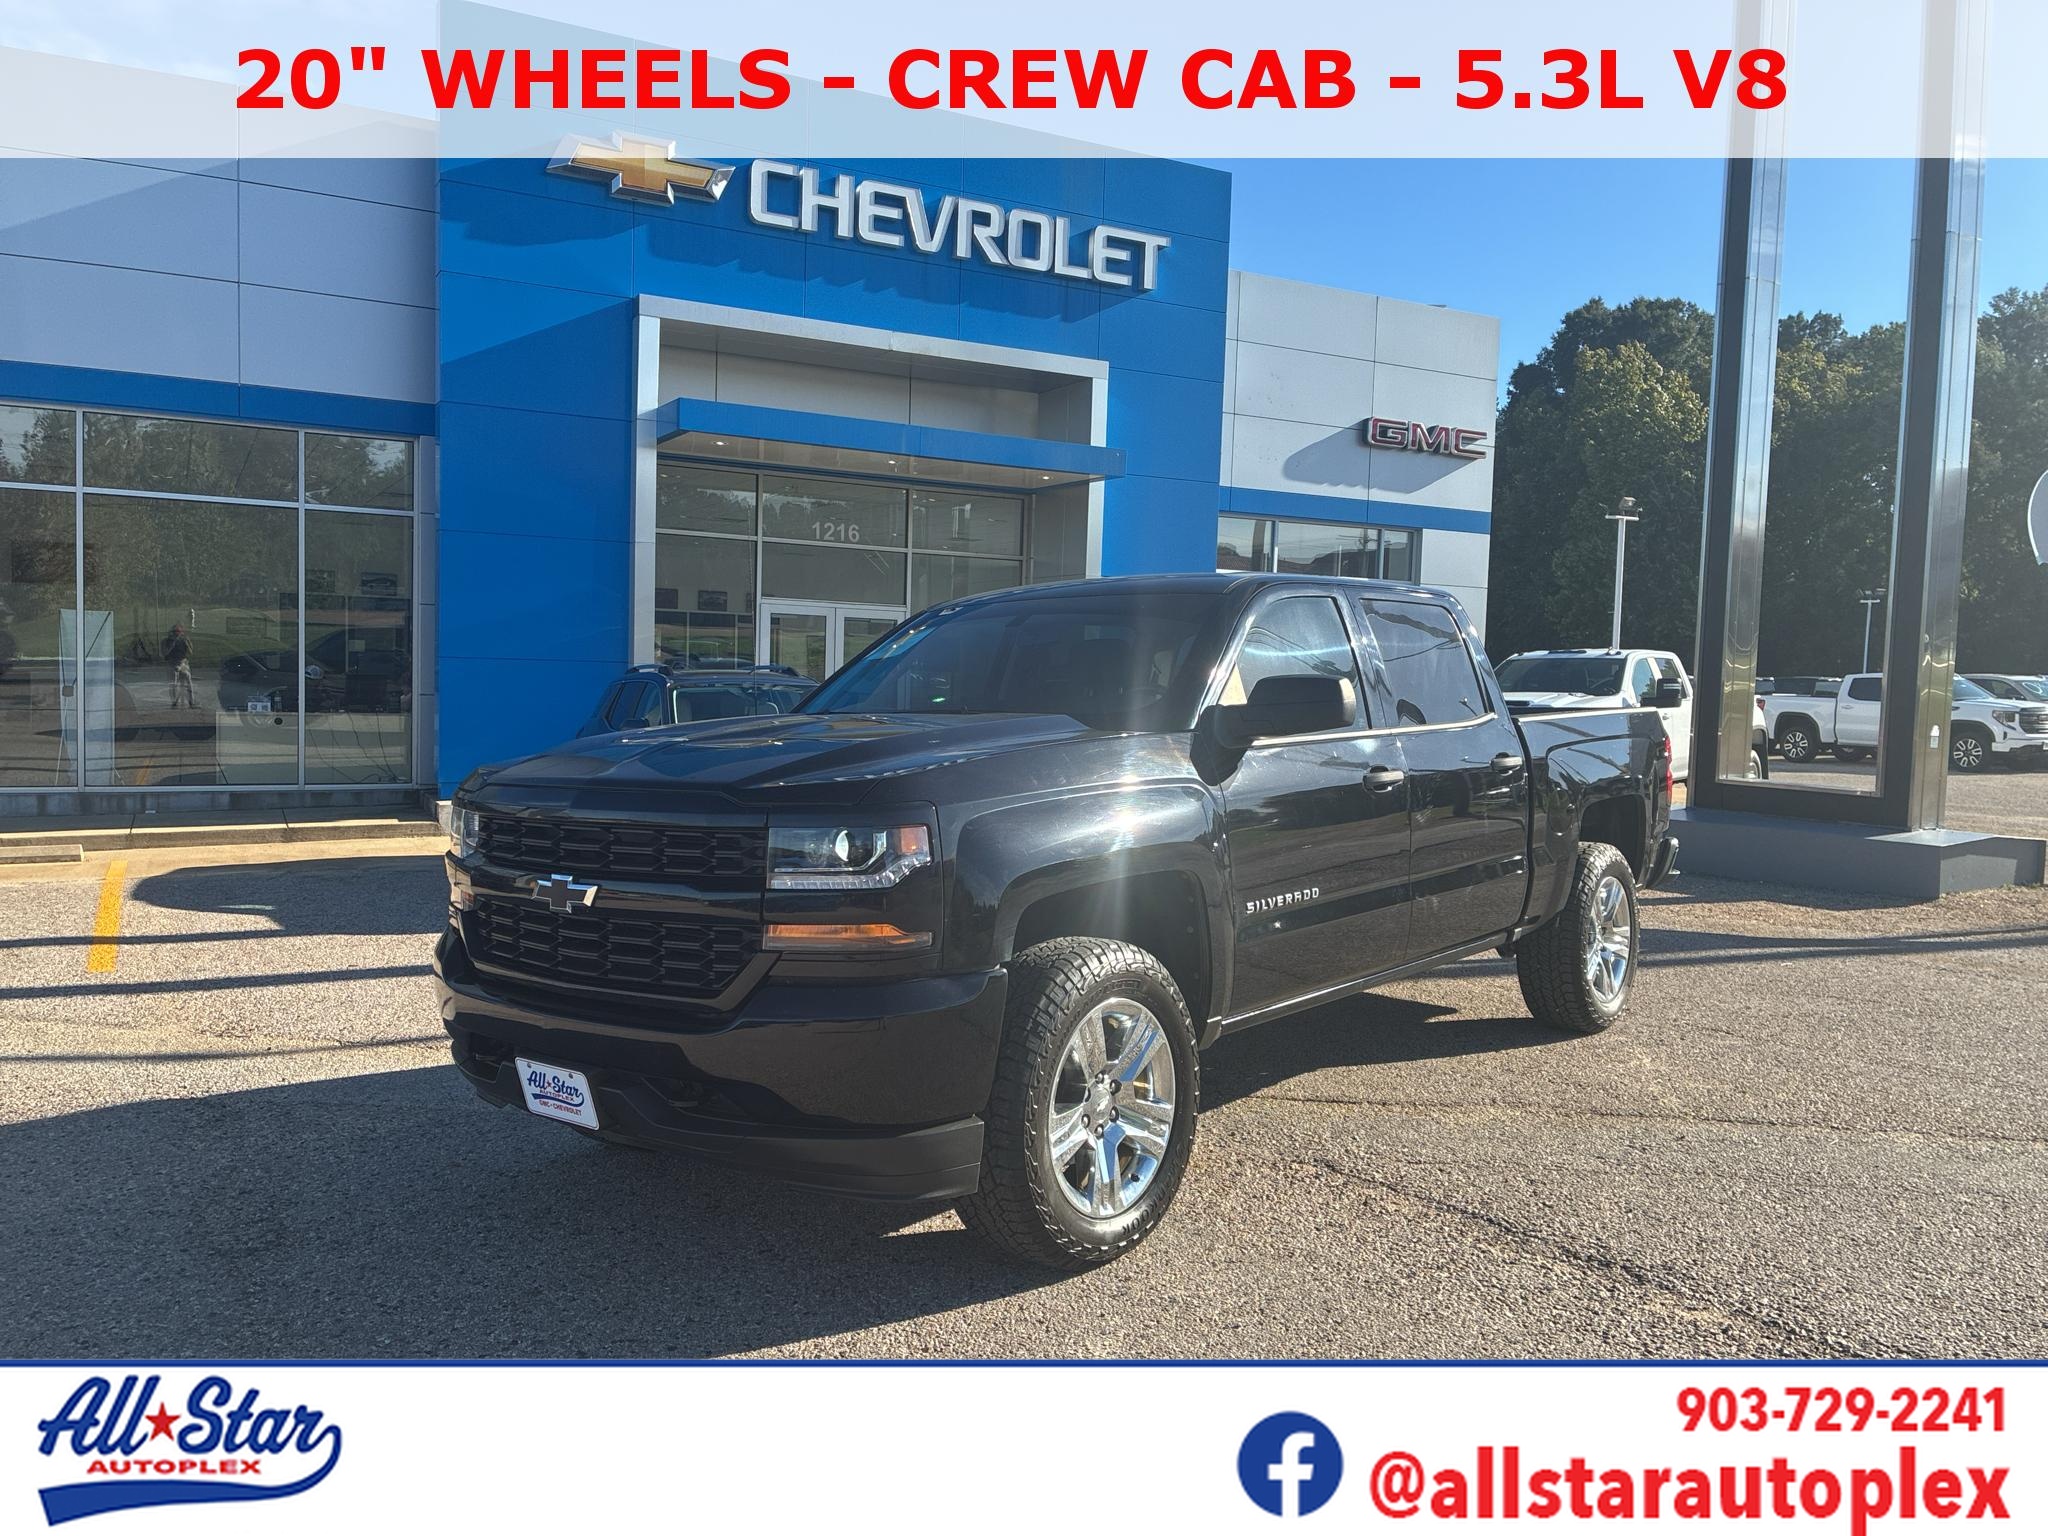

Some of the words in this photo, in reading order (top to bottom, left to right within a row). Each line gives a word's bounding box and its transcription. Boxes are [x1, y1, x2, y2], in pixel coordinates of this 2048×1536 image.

[750, 158, 1172, 291] CHEVROLET
[1367, 416, 1488, 460] GMC
[811, 521, 860, 543] 1216
[1245, 887, 1320, 914] SILVERADO
[527, 1070, 548, 1090] All
[551, 1075, 584, 1099] Star
[540, 1089, 575, 1102] AUTOPLEX
